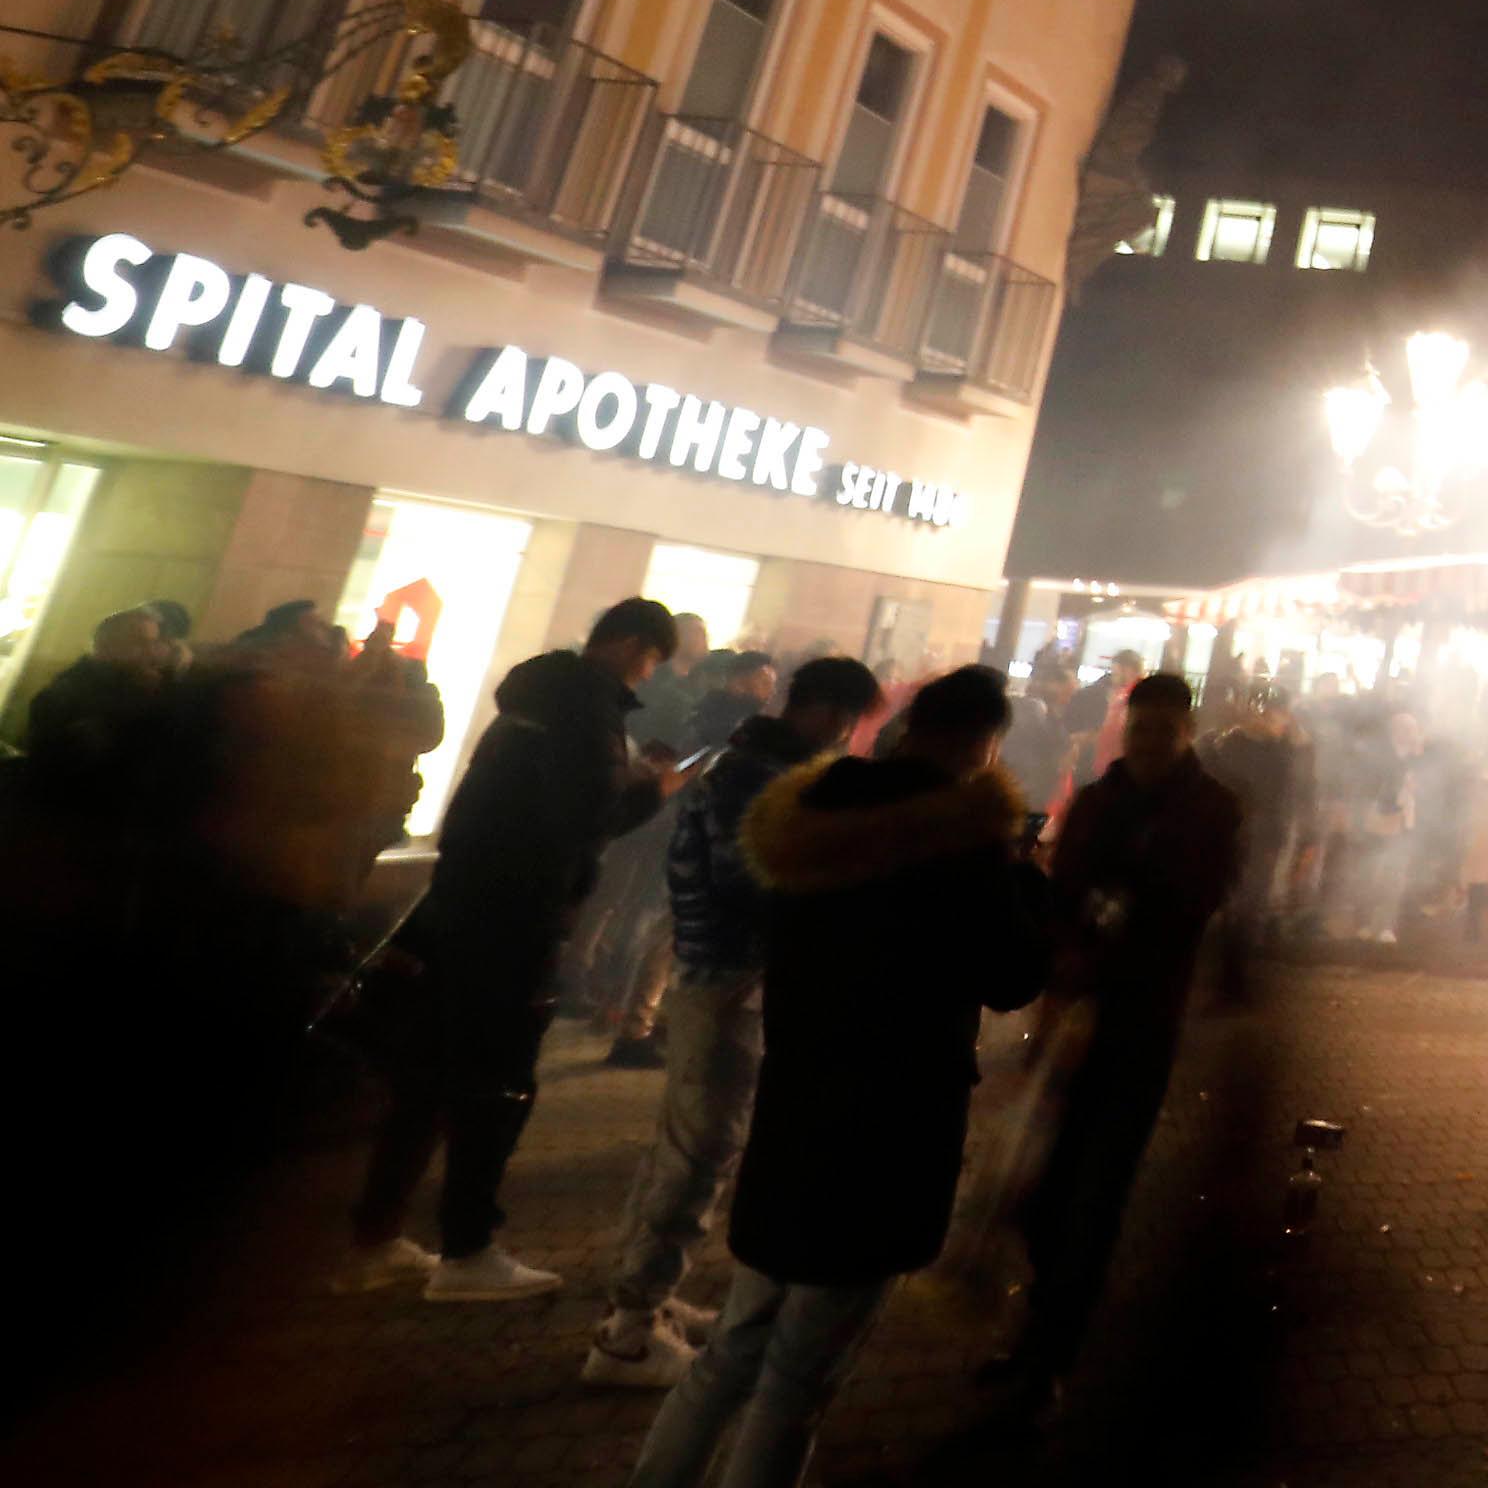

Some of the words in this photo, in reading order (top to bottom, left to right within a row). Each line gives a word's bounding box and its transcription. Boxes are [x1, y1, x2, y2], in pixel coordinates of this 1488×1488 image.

[62, 233, 426, 407] SPITAL
[464, 344, 830, 497] APOTHEKE
[837, 461, 903, 513] SEIT
